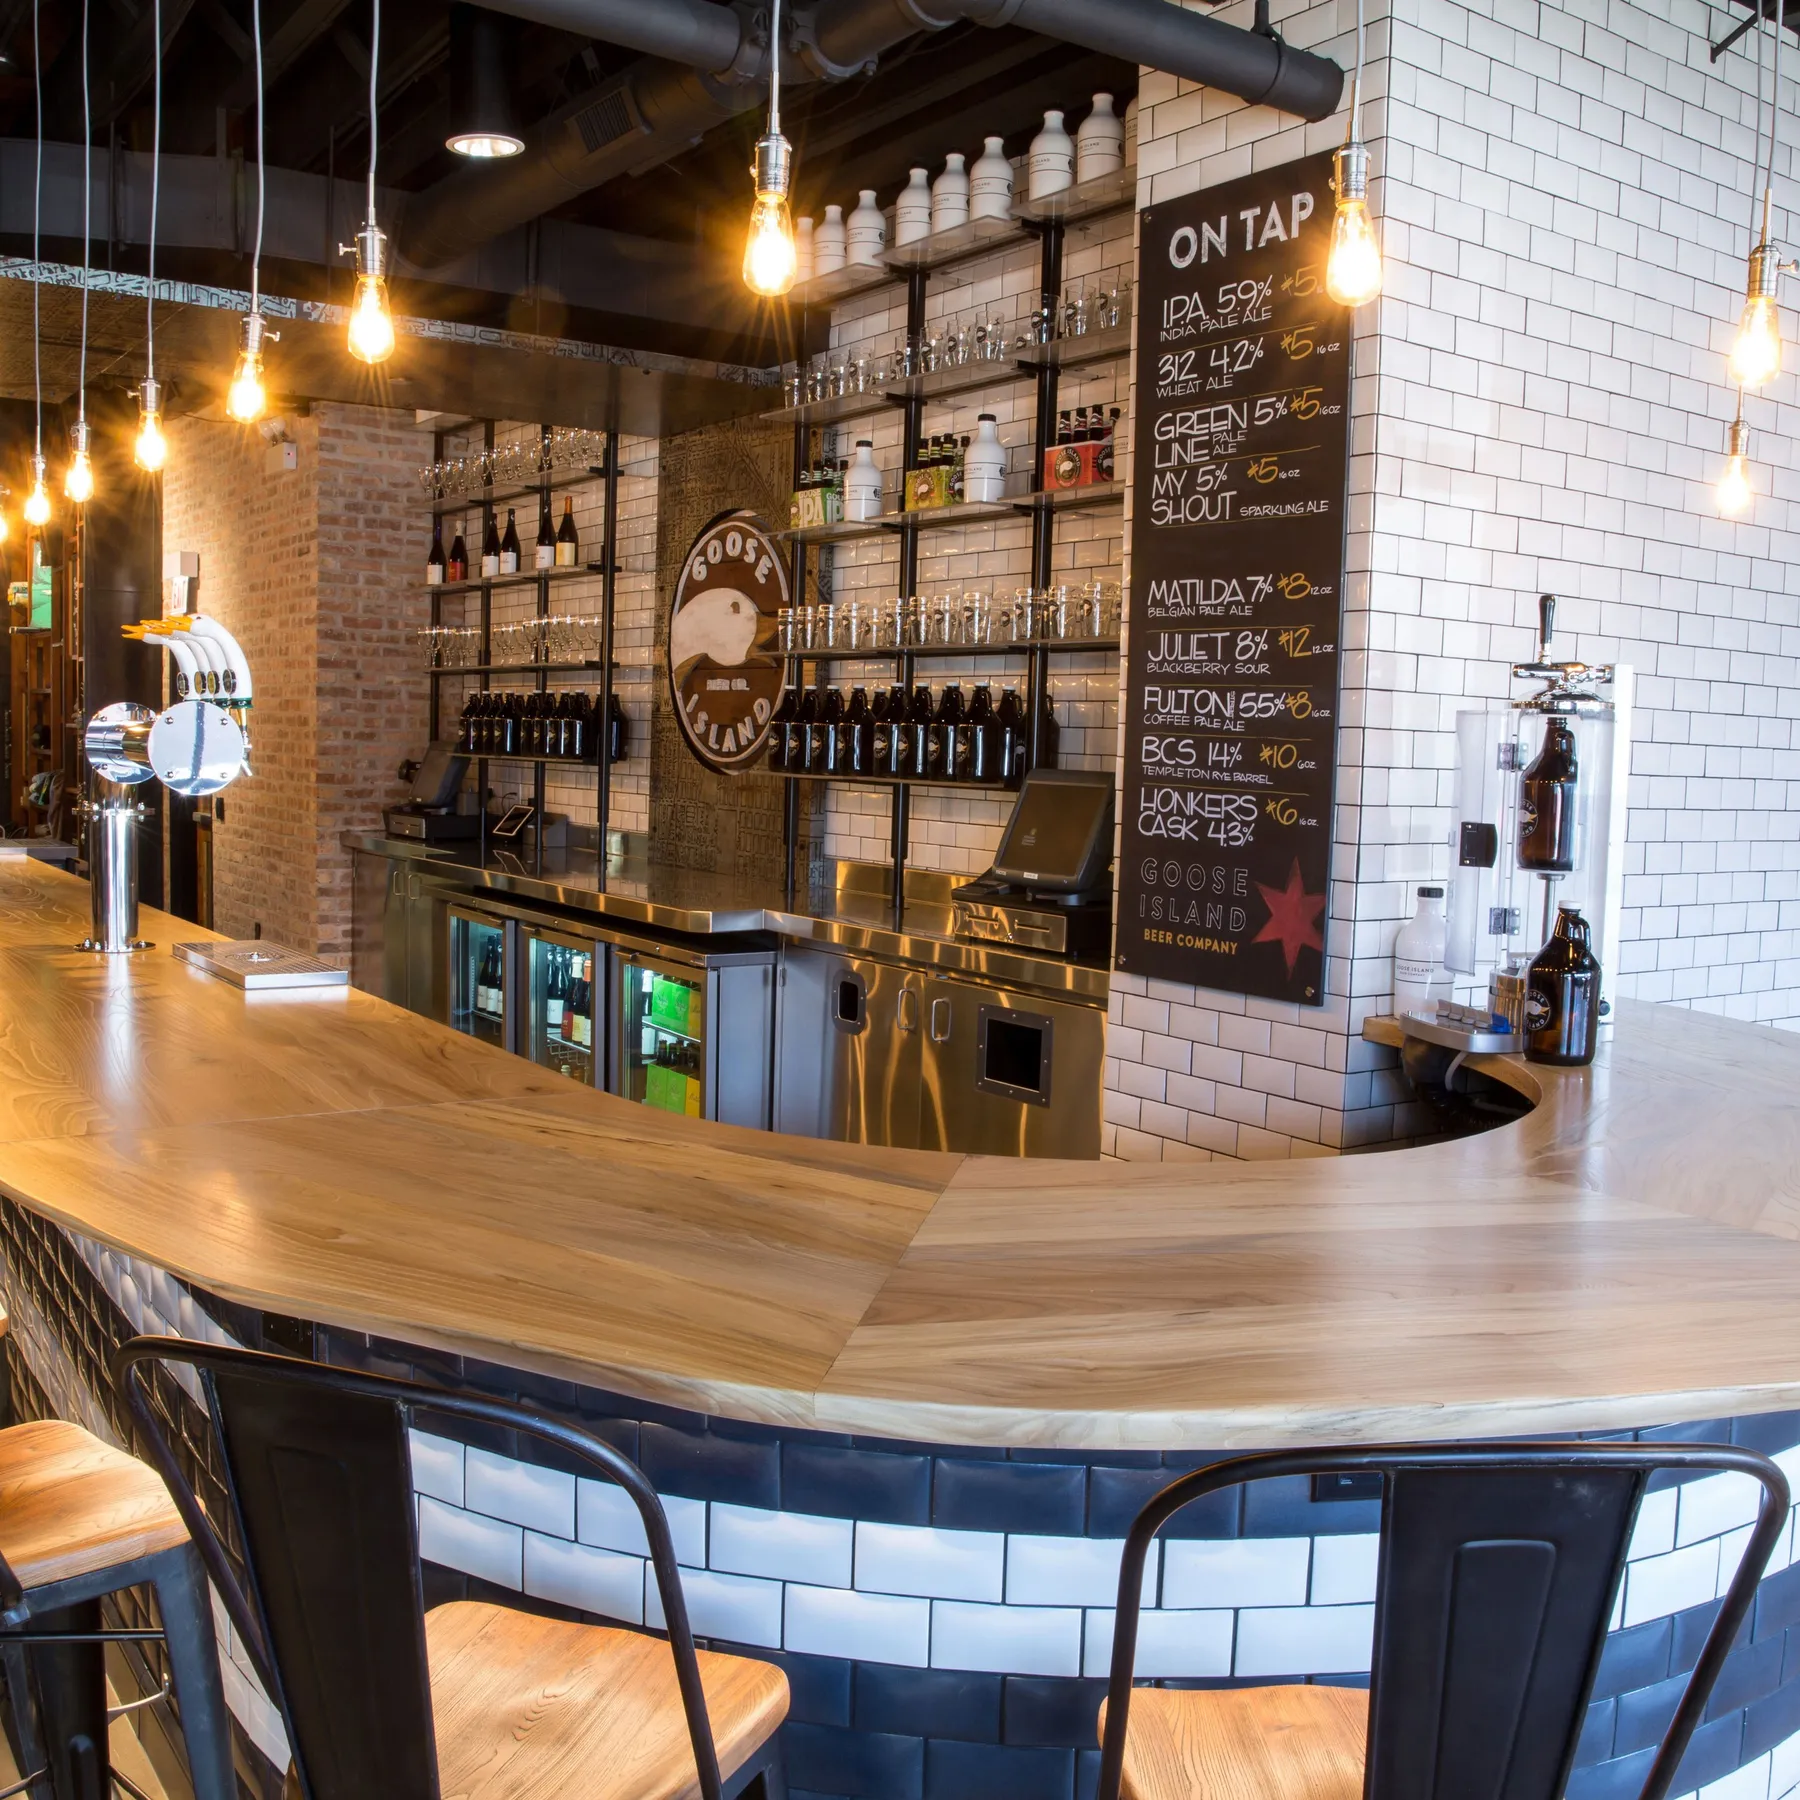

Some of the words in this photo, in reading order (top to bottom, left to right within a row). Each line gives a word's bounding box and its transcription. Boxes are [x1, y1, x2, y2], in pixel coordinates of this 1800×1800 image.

[1169, 215, 1228, 269] ON
[1240, 191, 1314, 251] TAP
[1163, 291, 1211, 329] I.P.A.
[1217, 274, 1273, 314] 5.9%
[1160, 325, 1197, 342] INDIA
[1200, 313, 1239, 333] PALE
[1242, 306, 1273, 323] ALE
[1158, 350, 1198, 386] 312
[1210, 336, 1264, 374] 4.2%
[1156, 380, 1203, 398] WHEAT
[1205, 374, 1234, 391] ALE
[1154, 402, 1247, 441] GREEN
[1254, 396, 1288, 426] 5%
[1155, 435, 1210, 469] LINE
[1212, 443, 1237, 456] ALE
[1212, 430, 1248, 444] PALE
[1152, 469, 1188, 499] MY
[1196, 462, 1228, 492] 5%
[798, 495, 824, 529] IPA
[1151, 491, 1238, 526] SHOUT
[1239, 501, 1305, 517] SPARKLING
[1306, 500, 1329, 513] ALE
[692, 531, 773, 584] GOOSE
[1147, 578, 1245, 607] MATILDA
[1246, 574, 1274, 602] 7%
[1148, 605, 1196, 618] BELGIAN
[1199, 605, 1225, 616] PALE
[1229, 604, 1253, 616] ALE
[1148, 631, 1230, 662] JULIET
[1234, 629, 1269, 661] 8%
[1147, 662, 1230, 676] BLACKBERRY
[1234, 662, 1271, 675] SOUR
[1144, 686, 1230, 718] FULTON
[1238, 692, 1286, 718] 5.5%
[686, 697, 771, 752] ISLAND
[1143, 715, 1190, 726] COFFEE
[1194, 715, 1221, 728] PALE
[1223, 719, 1245, 732] ALE
[1141, 736, 1196, 765] BCS
[1208, 741, 1242, 768] 14%
[1142, 765, 1210, 780] TEMPLETON
[1212, 770, 1232, 781] RYE
[1233, 773, 1273, 785] BARREL
[1140, 786, 1258, 821] HONKERS
[1138, 811, 1199, 841] CASK
[1207, 821, 1255, 847] 4.3%
[1141, 857, 1248, 897] GOOSE
[1140, 894, 1246, 932] ISLAND
[1144, 928, 1172, 944] BEER
[1176, 933, 1238, 955] COMPANY
